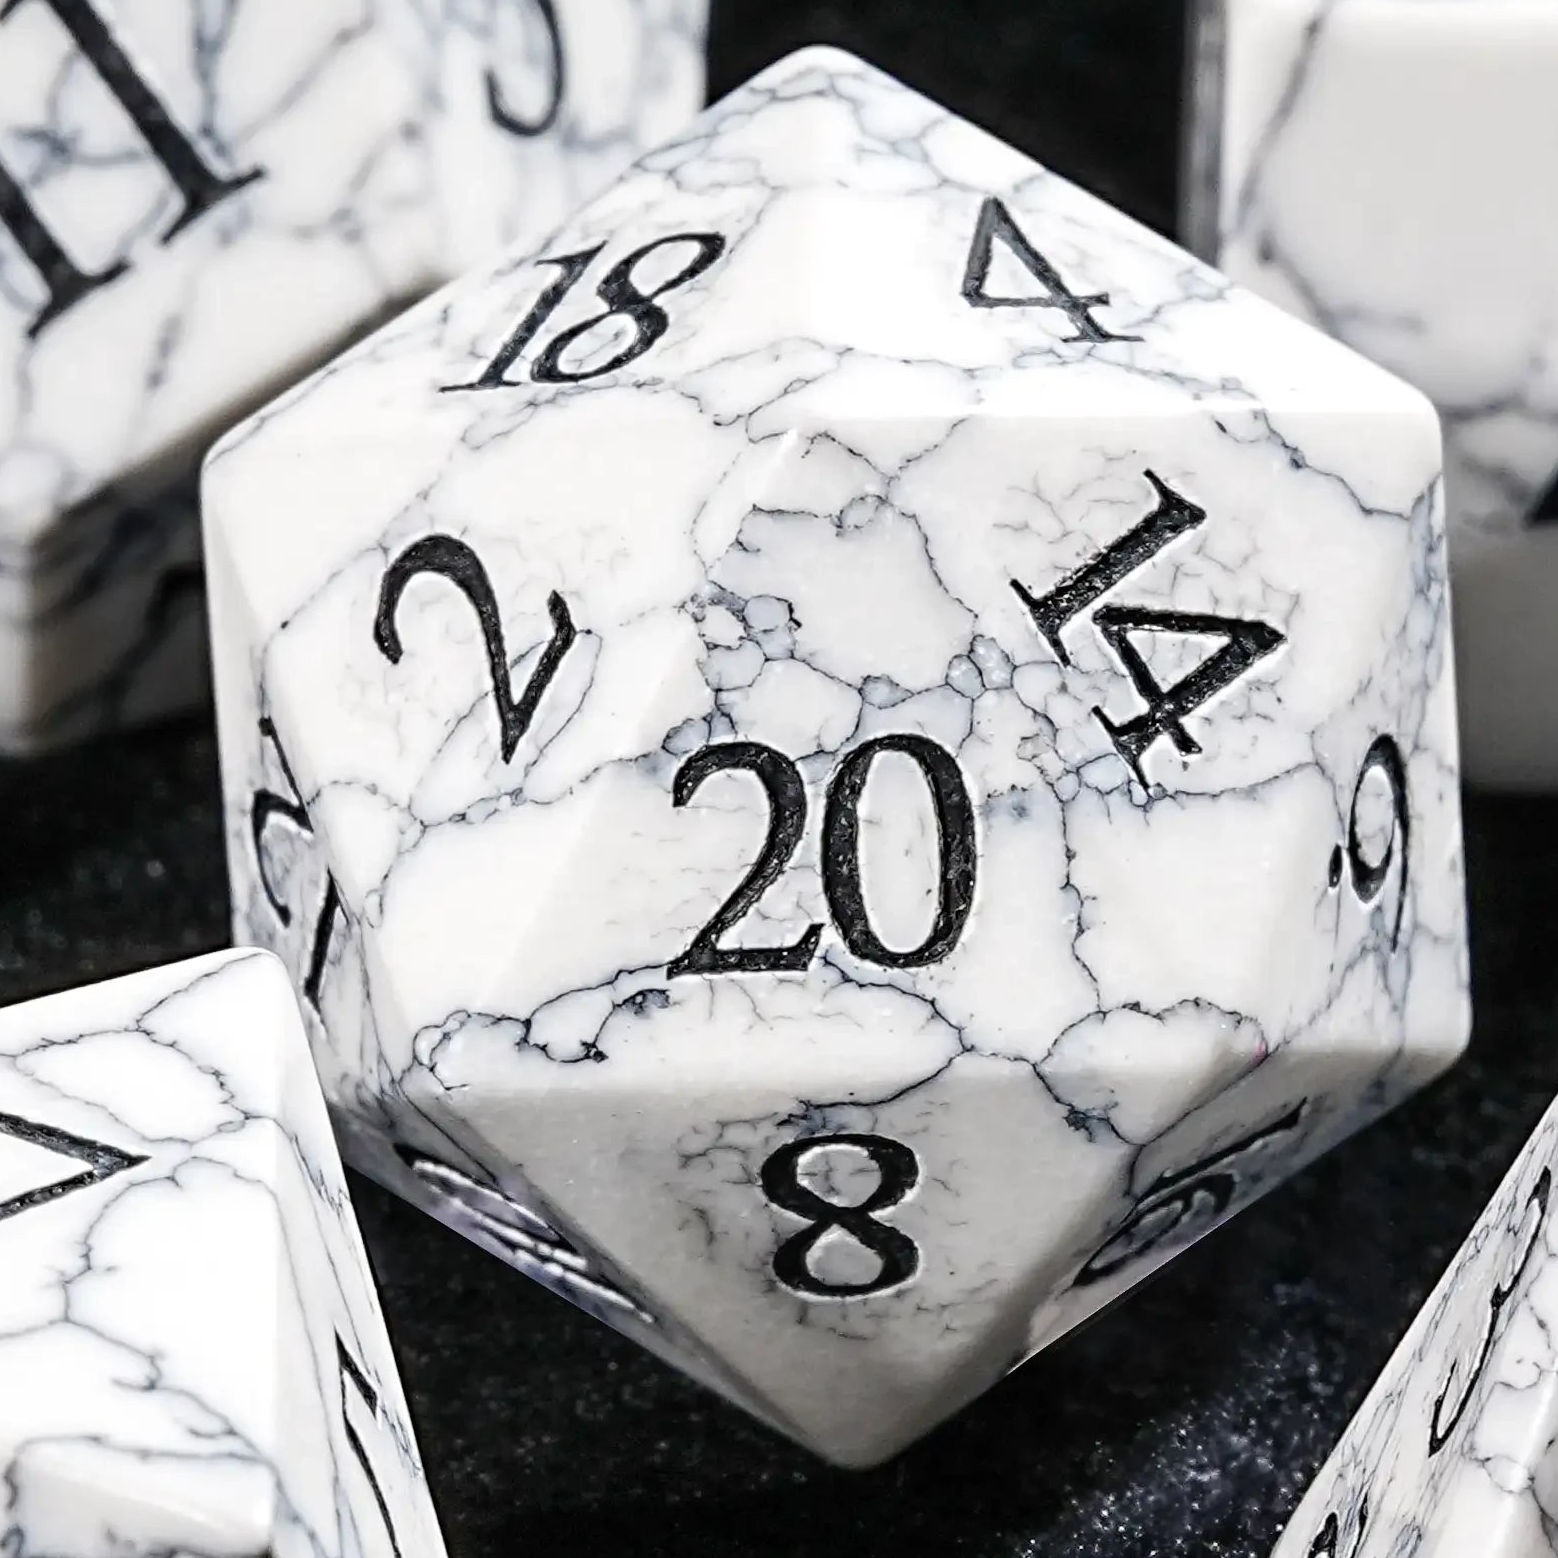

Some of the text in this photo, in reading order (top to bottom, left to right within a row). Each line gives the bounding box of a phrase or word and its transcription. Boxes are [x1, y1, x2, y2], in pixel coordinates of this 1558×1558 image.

[437, 230, 727, 392] 18
[960, 195, 1146, 344] 4
[372, 533, 579, 767] 2
[1007, 466, 1287, 791] 14
[665, 731, 978, 982] 20
[758, 1131, 920, 1299] 8
